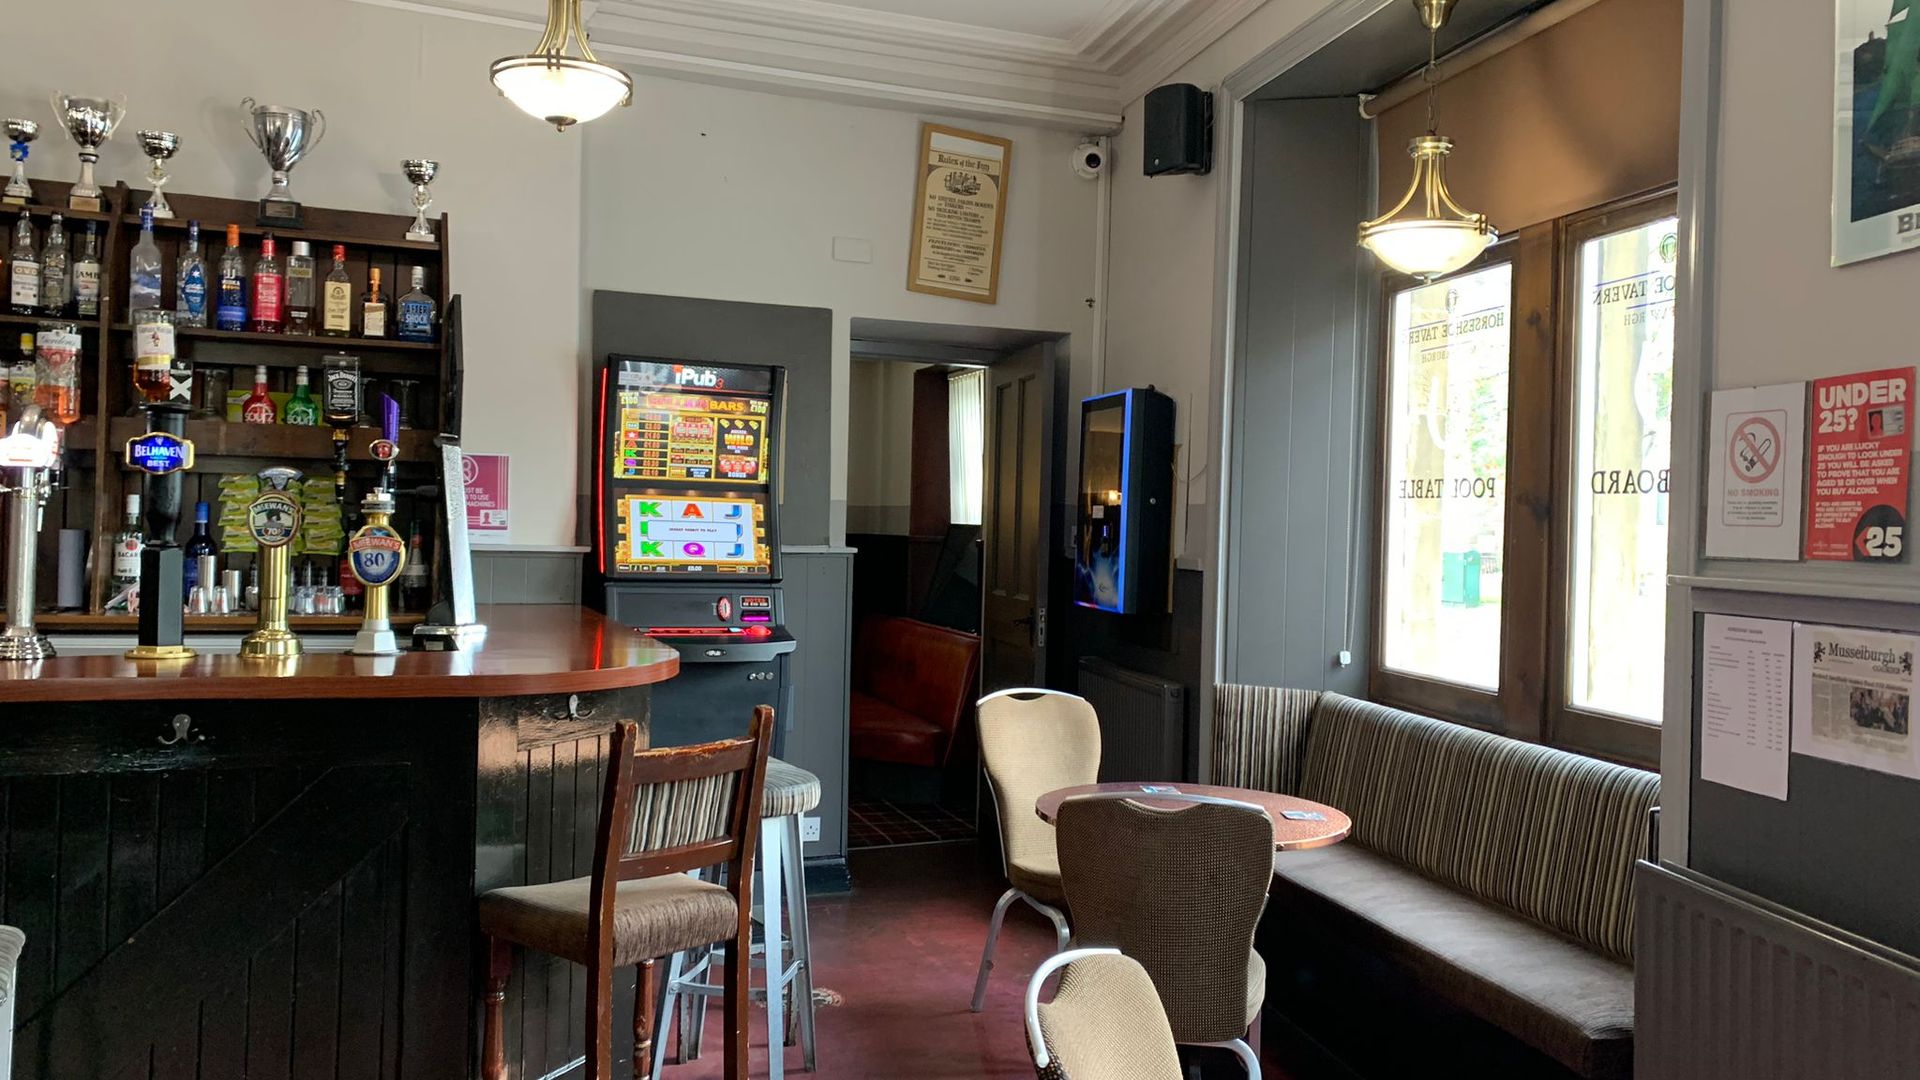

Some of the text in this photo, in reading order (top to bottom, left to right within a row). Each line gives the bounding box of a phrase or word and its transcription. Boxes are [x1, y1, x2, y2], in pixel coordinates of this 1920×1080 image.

[1819, 377, 1907, 409] UNDER
[709, 400, 746, 412] BARS
[1818, 408, 1858, 433] 25?
[135, 444, 185, 459] BELHAVEN
[1826, 444, 1840, 452] YOU
[1854, 442, 1880, 450] LUCKY
[1818, 453, 1847, 461] ENOUGH
[1847, 452, 1856, 460] TO
[1857, 451, 1879, 459] LOOK
[1843, 461, 1859, 469] WILL
[1860, 460, 1870, 468] BE
[1872, 459, 1894, 467] ASKED
[1828, 470, 1851, 478] PROVE
[1851, 469, 1870, 477] THAT
[1856, 478, 1875, 486] OVER
[1876, 477, 1898, 485] WHEN
[1727, 488, 1780, 497] NO SMOKING
[1816, 488, 1832, 496] YOU
[682, 503, 705, 519] A
[1866, 526, 1902, 557] 25
[364, 552, 385, 568] 80
[1828, 642, 1896, 668] Musselburgh
